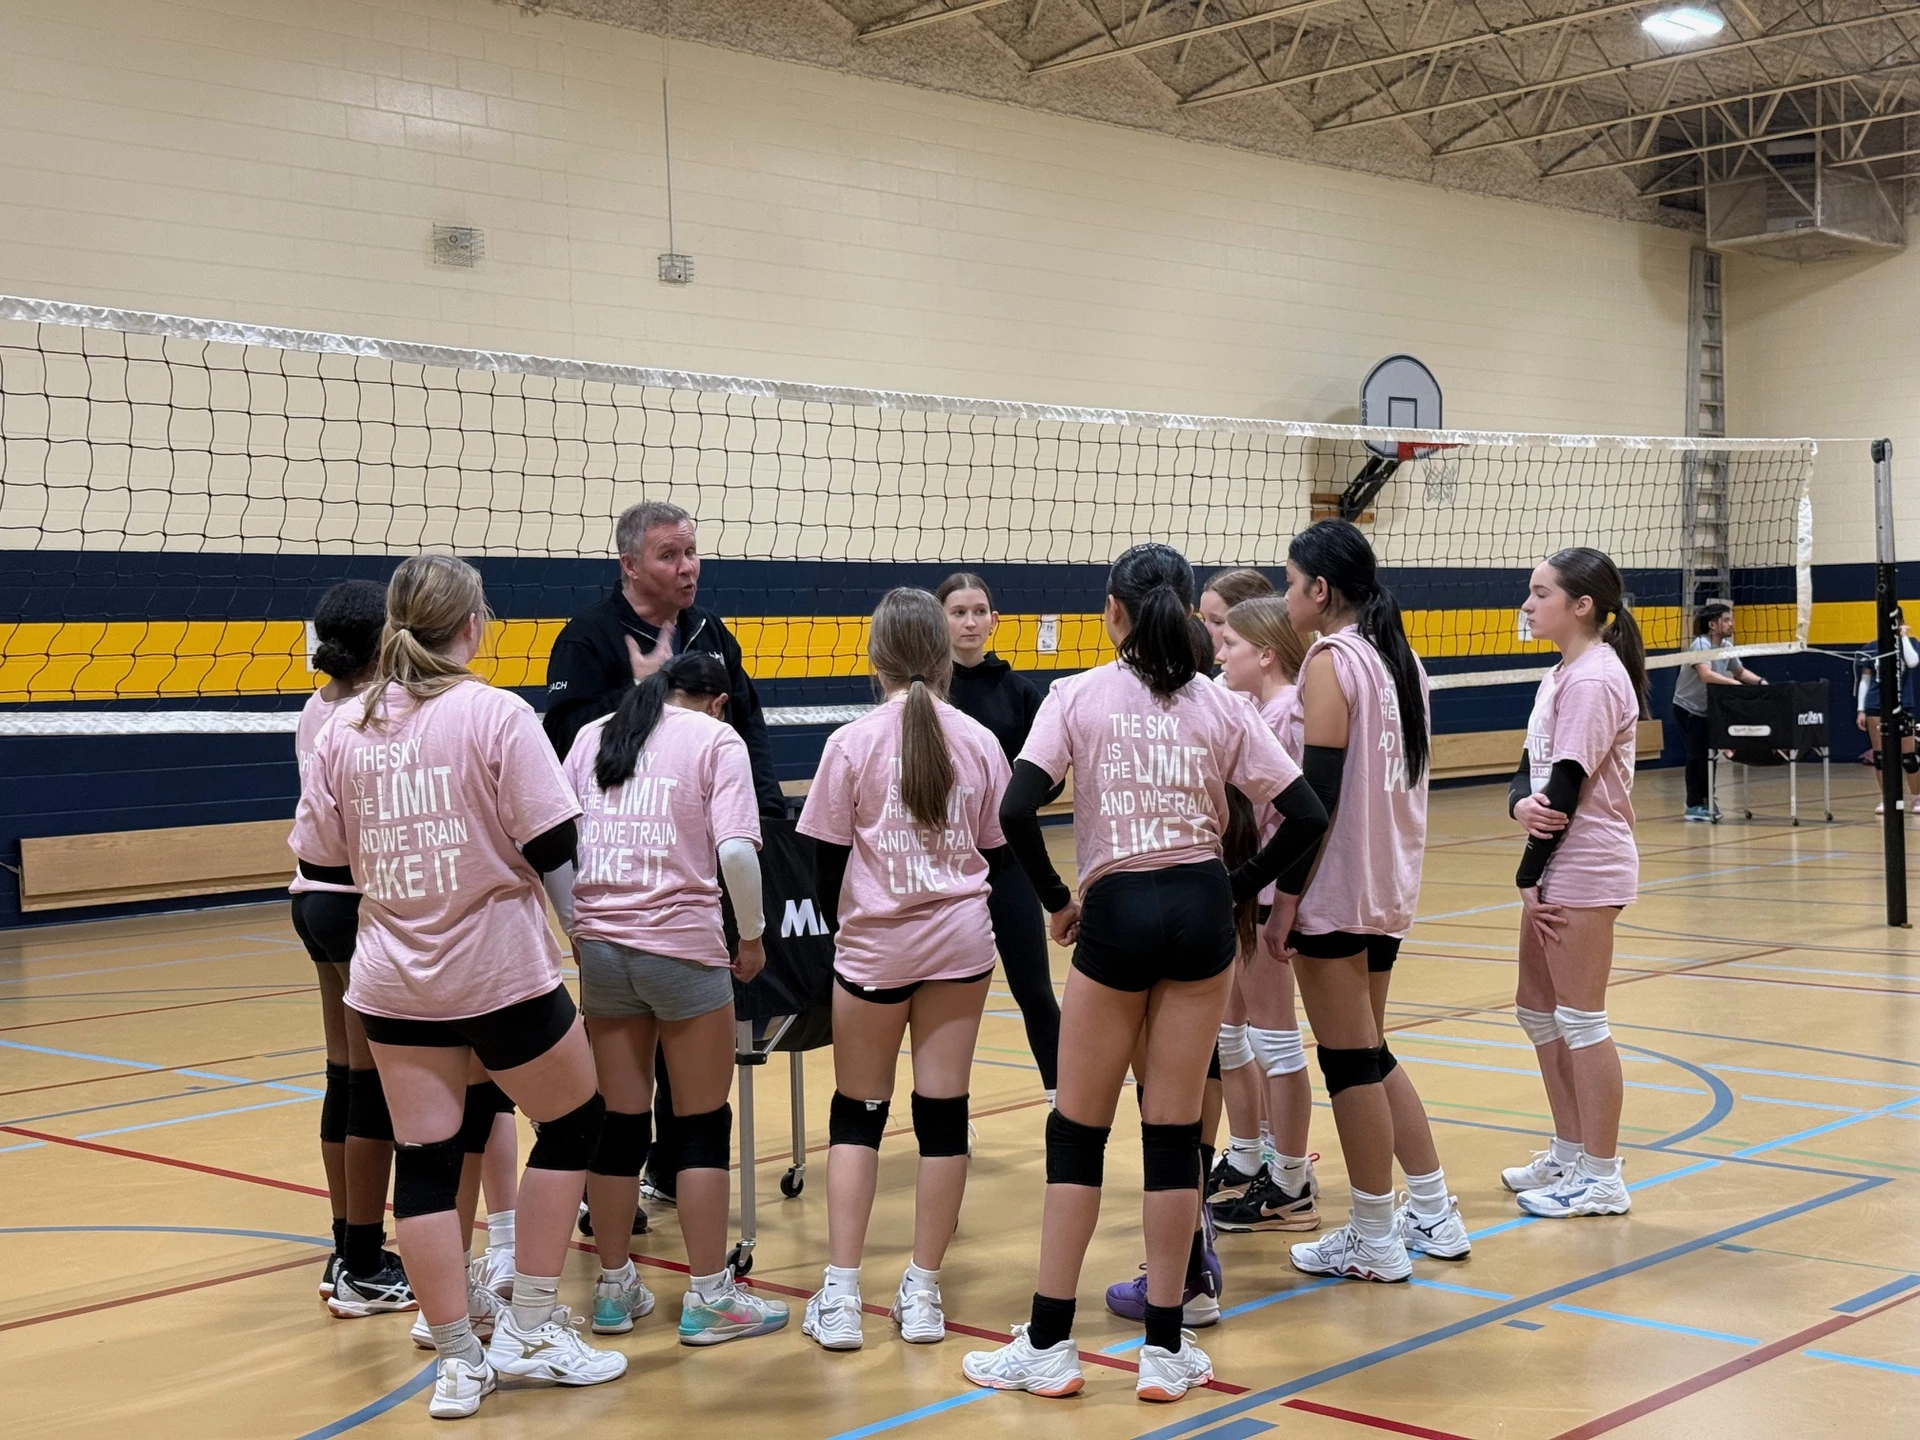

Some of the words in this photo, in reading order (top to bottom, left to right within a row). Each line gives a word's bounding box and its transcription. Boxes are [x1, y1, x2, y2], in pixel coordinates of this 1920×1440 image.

[1380, 687, 1390, 704] IS
[1109, 713, 1142, 738] THE
[1145, 714, 1180, 740] SKY
[354, 744, 386, 773] THE
[389, 736, 422, 769] SKY
[1100, 761, 1132, 780] THE
[1132, 744, 1208, 789] LIMIT
[1107, 742, 1122, 761] IS
[376, 765, 452, 820] LIMIT
[581, 793, 601, 811] THE
[603, 776, 679, 817] LIMIT
[1100, 790, 1136, 816] AND
[1139, 789, 1169, 813] WE
[381, 825, 410, 853] WE
[413, 817, 469, 849] TRAIN
[603, 821, 627, 845] WE
[630, 821, 677, 846] TRAIN
[877, 829, 911, 853] AND
[433, 848, 461, 894] IT
[642, 848, 669, 887] IT
[887, 853, 949, 895] LIKE
[946, 852, 973, 886] IT
